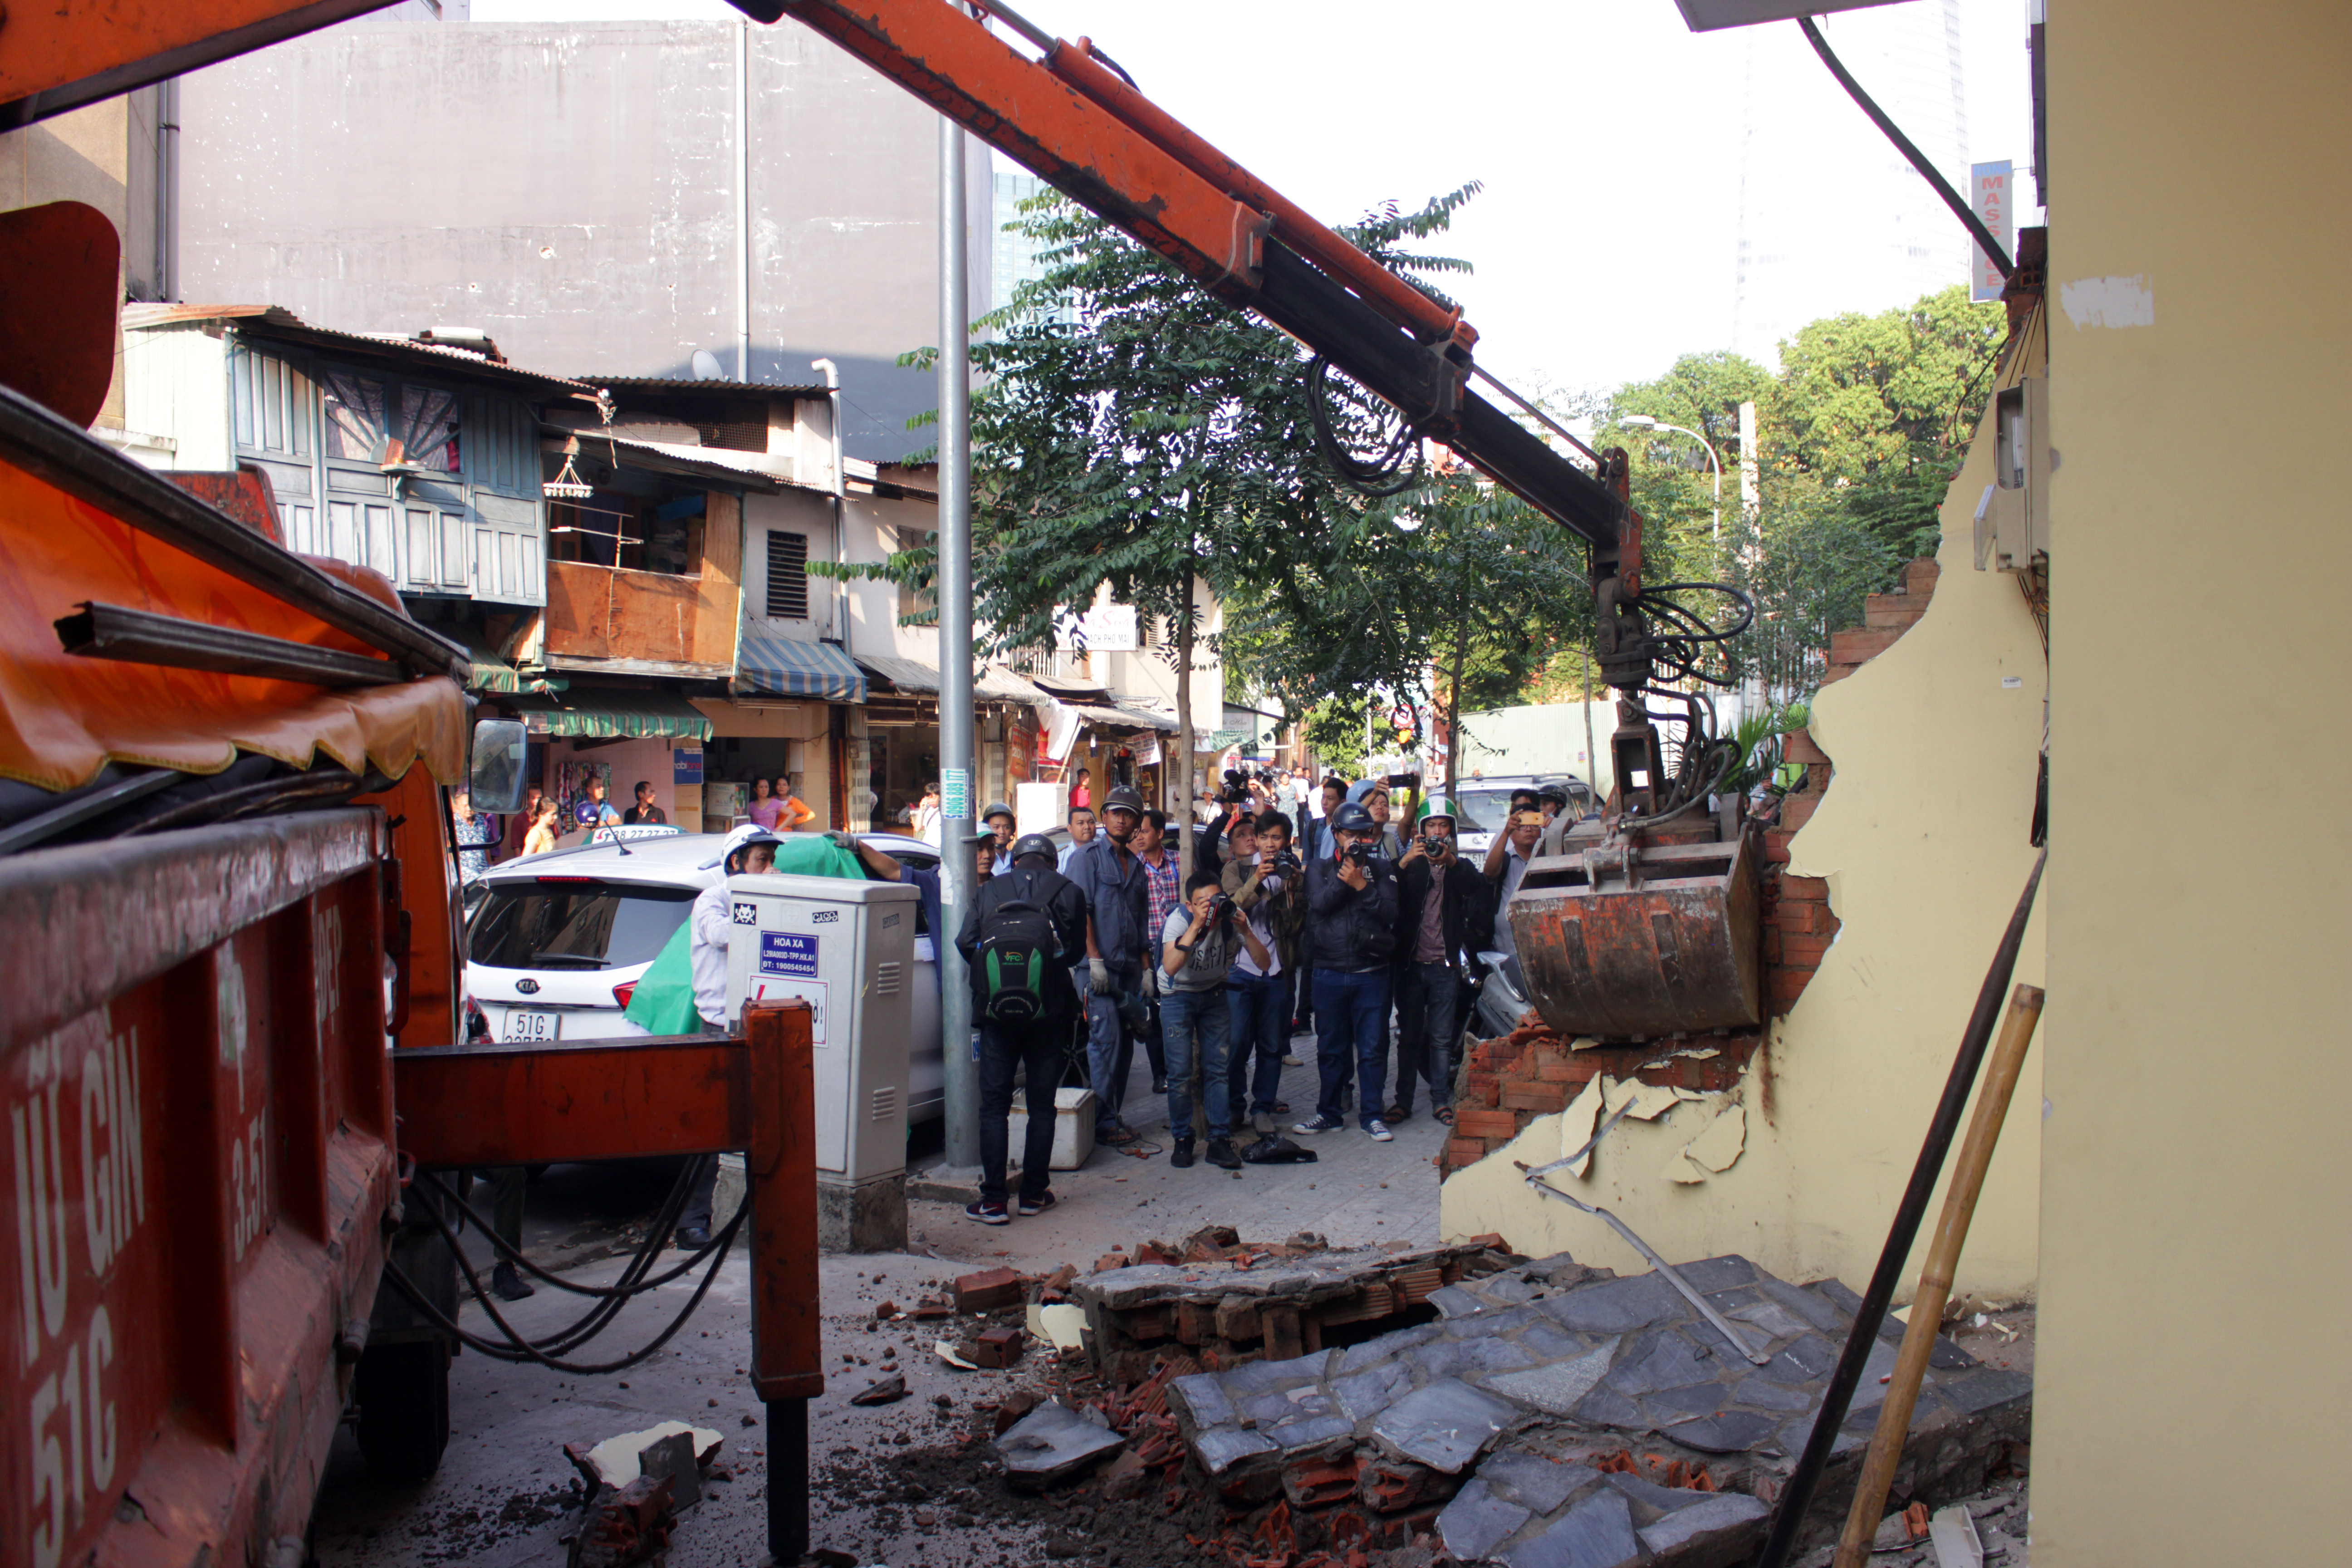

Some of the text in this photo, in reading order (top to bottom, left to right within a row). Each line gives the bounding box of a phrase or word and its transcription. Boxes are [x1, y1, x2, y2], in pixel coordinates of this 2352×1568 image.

[1974, 162, 2011, 176] RONA
[1118, 634, 1129, 644] MAI
[946, 770, 965, 814] 0906.889.177
[774, 937, 804, 948] HOA XA
[776, 962, 814, 972] 1900545454
[519, 981, 537, 991] KIA
[517, 1014, 544, 1035] 51G
